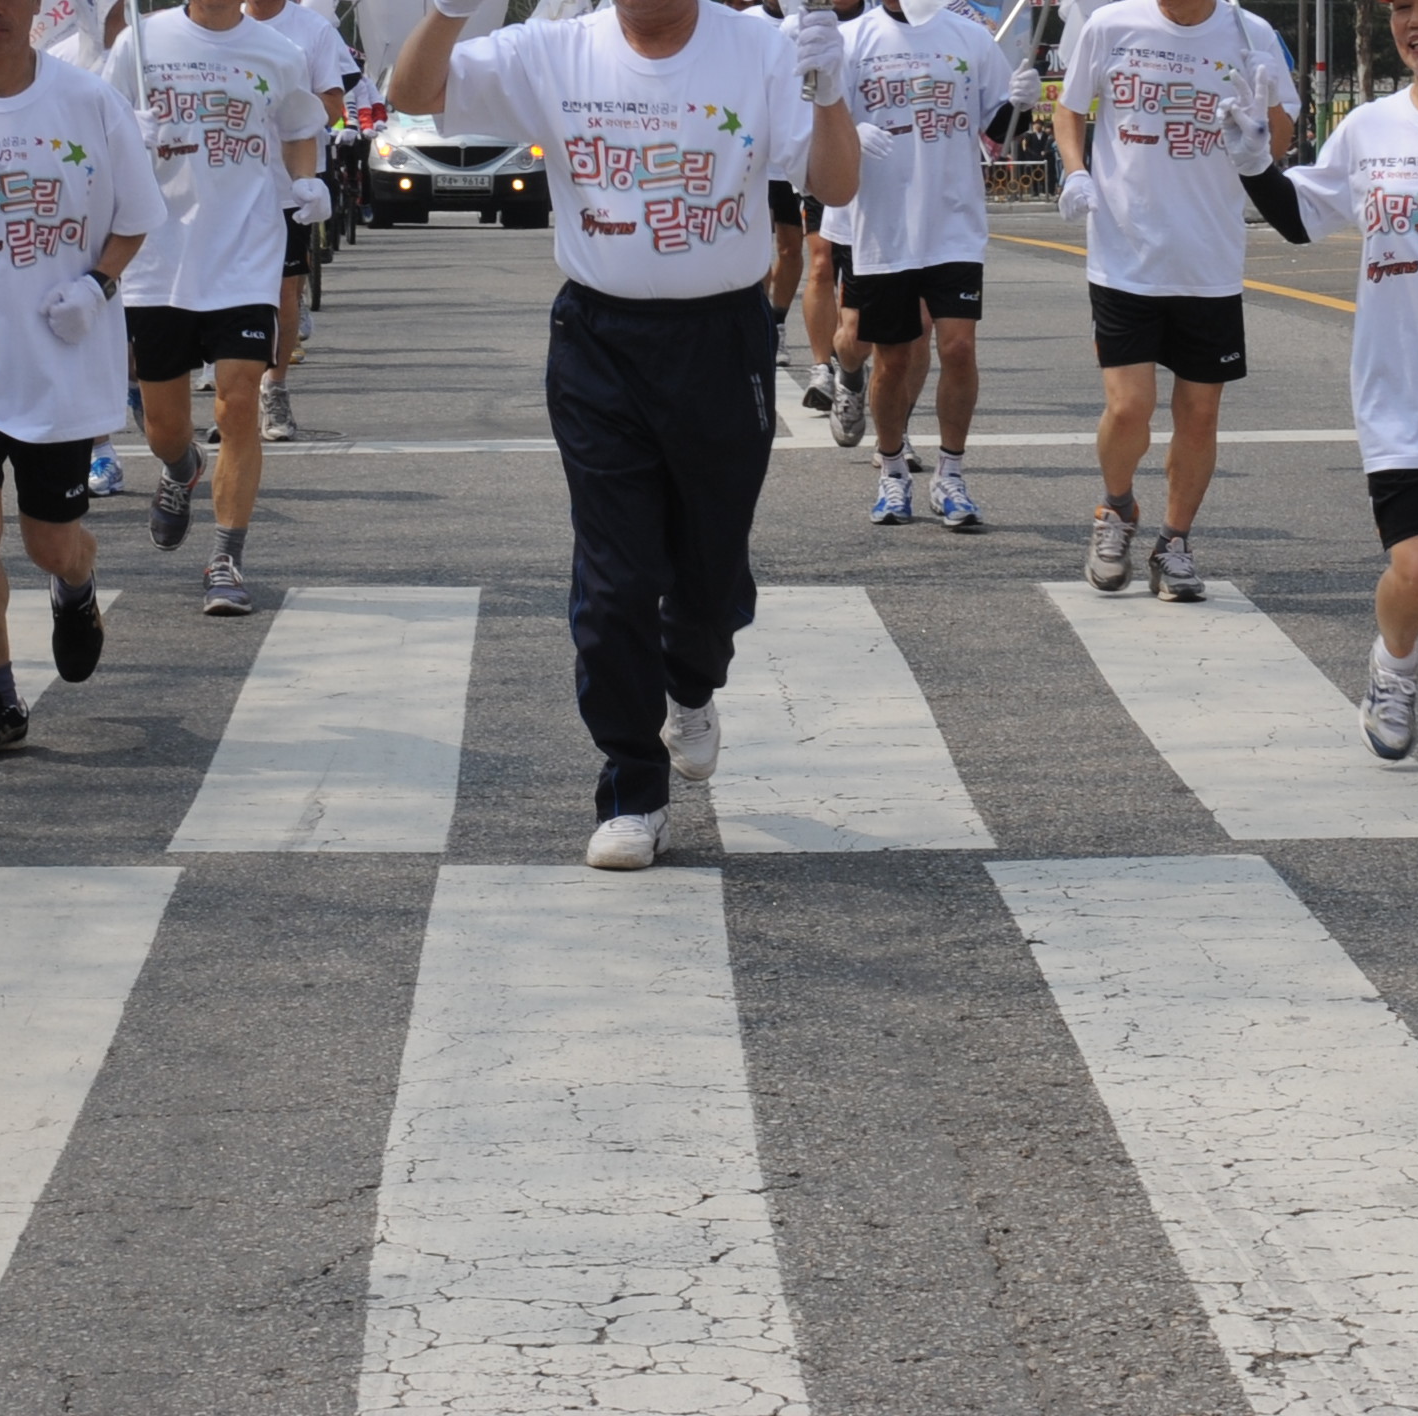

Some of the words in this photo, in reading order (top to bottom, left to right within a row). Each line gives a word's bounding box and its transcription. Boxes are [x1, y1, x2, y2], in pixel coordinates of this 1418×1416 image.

[201, 72, 216, 83] V3
[1168, 63, 1183, 74] V3
[859, 74, 955, 114] 희망드림
[1111, 71, 1220, 124] 희망드림
[148, 86, 252, 132] 희망드림
[561, 100, 649, 114] 인천세계도시축전
[650, 102, 679, 115] 성공과
[587, 117, 603, 129] SK
[604, 118, 640, 129] 와이번스
[641, 117, 661, 131] V3
[204, 129, 269, 168] 릴레이
[564, 136, 716, 197] 희망드림
[1371, 170, 1385, 181] SK
[581, 213, 637, 238] Wyverns
[596, 208, 610, 219] SK
[644, 191, 748, 255] 릴레이
[6, 214, 89, 269] 릴레이
[1383, 251, 1396, 261] SK
